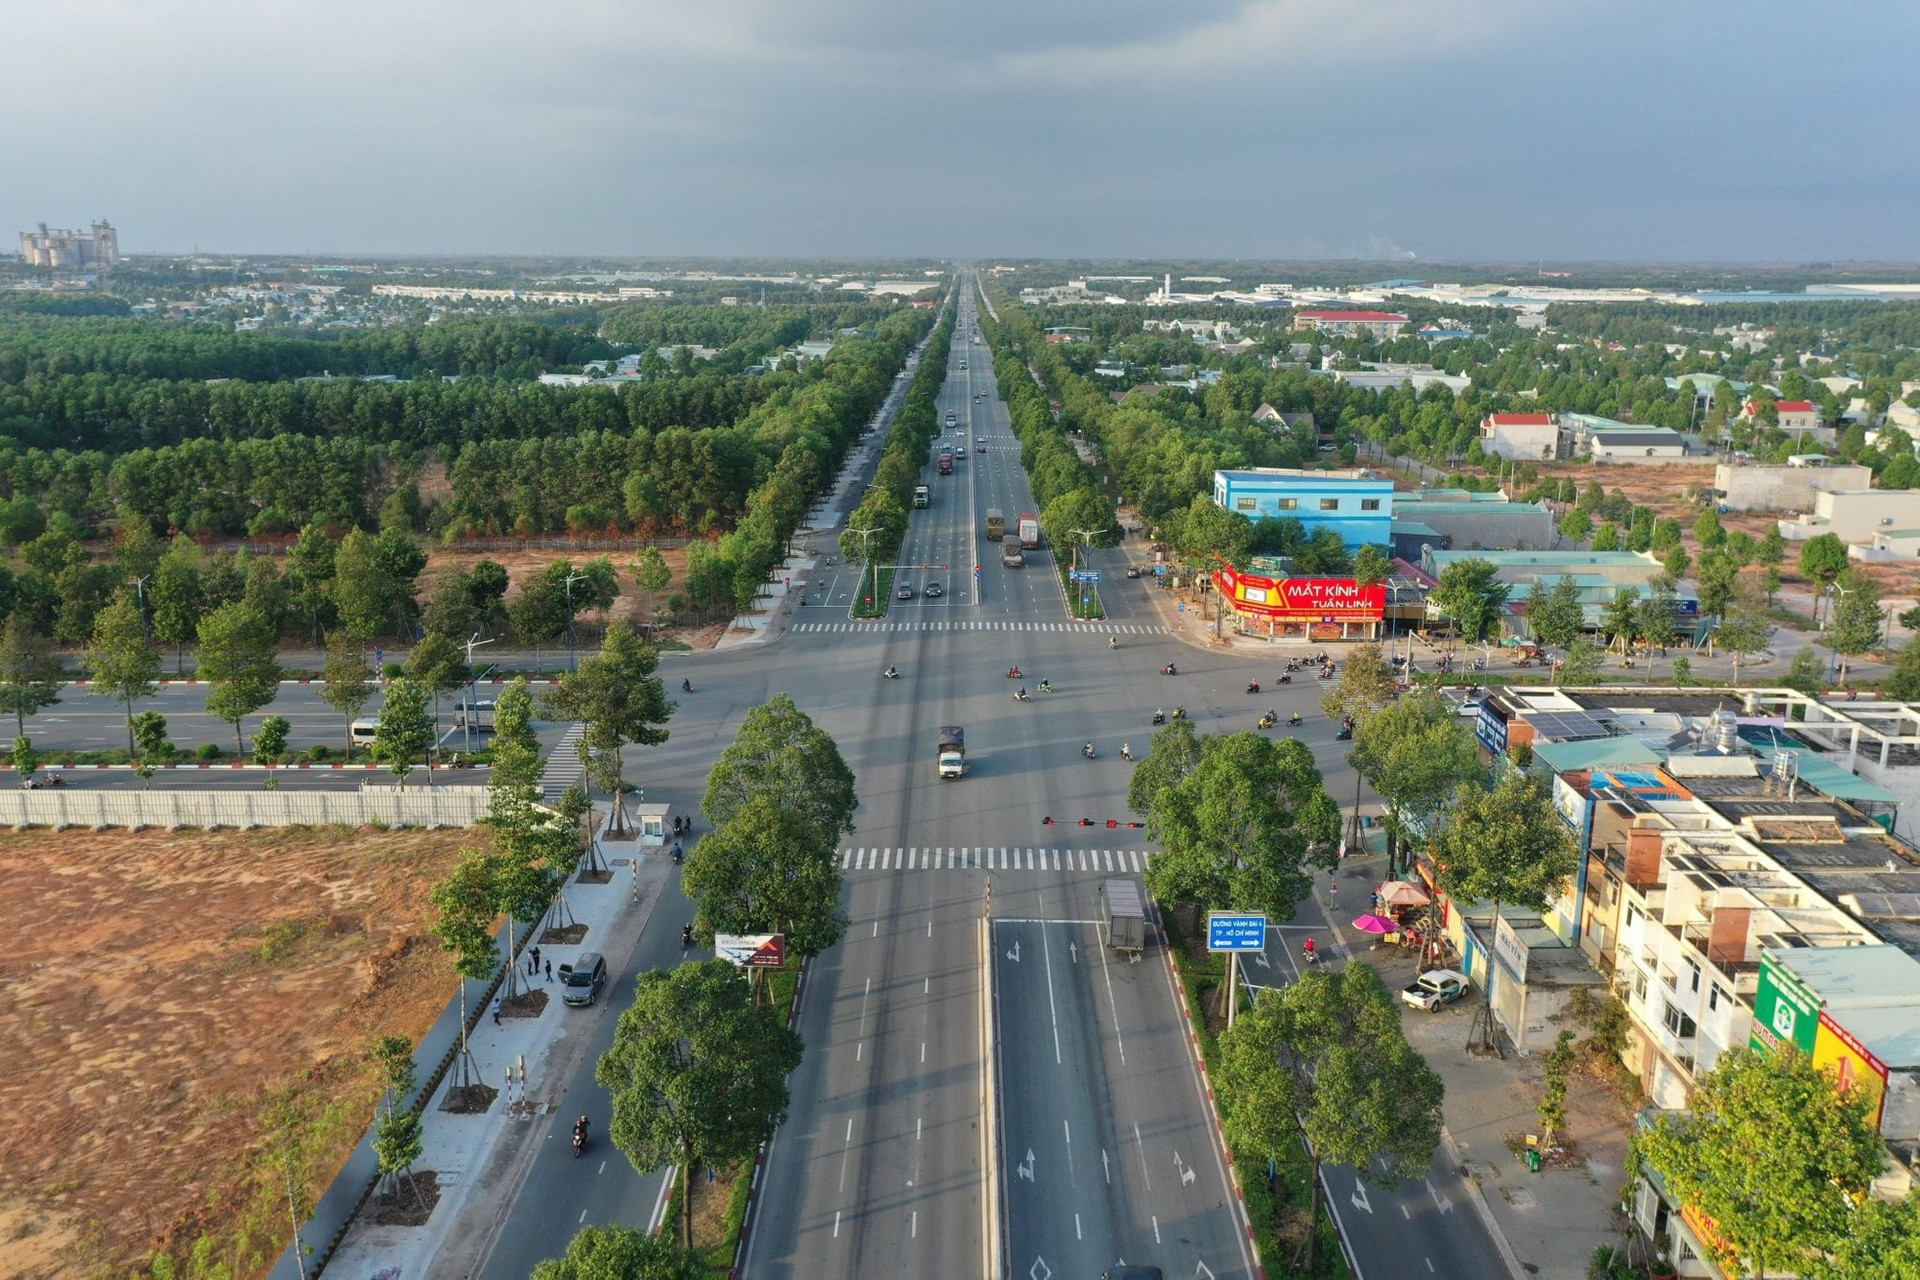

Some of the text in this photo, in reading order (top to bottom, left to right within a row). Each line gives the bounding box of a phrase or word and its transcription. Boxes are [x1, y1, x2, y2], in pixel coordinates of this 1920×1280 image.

[1288, 581, 1358, 596] MẮT KÍNH
[1346, 600, 1372, 608] LINH
[1233, 919, 1248, 927] VÀNH
